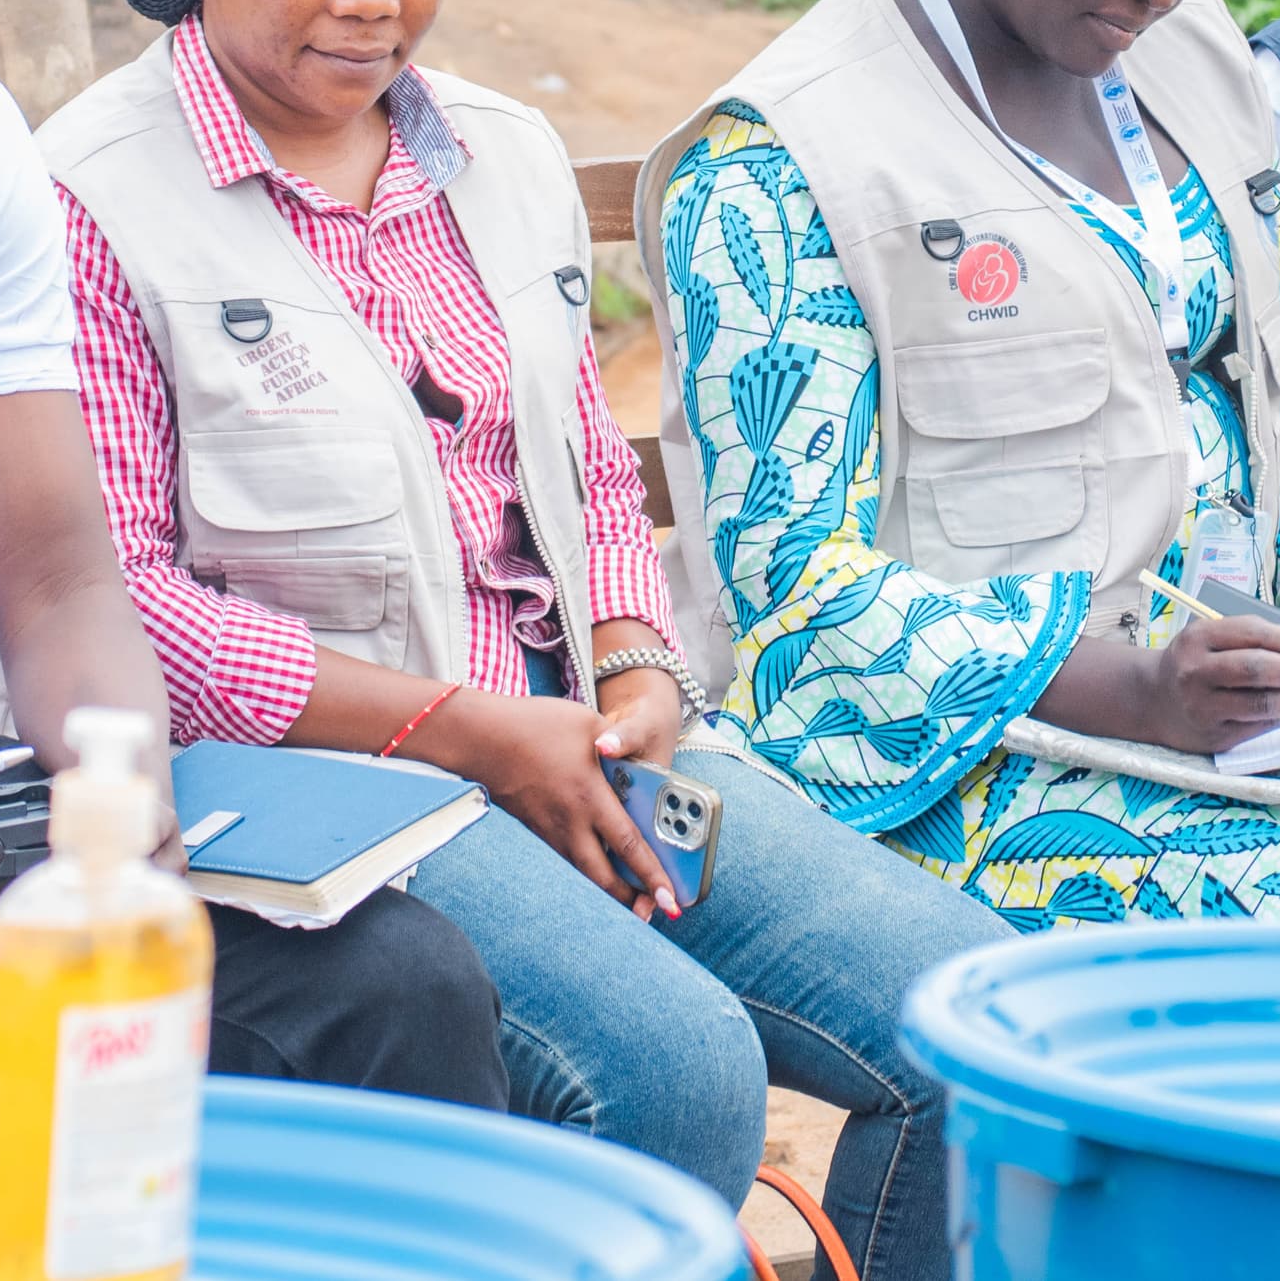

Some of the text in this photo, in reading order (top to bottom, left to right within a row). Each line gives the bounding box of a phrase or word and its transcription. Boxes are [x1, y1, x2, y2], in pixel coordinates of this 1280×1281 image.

[967, 305, 1019, 322] CHWID
[236, 331, 295, 368] URGENT
[260, 342, 311, 377] ACTION
[260, 363, 302, 395] FUND
[275, 370, 328, 405] AFRICA
